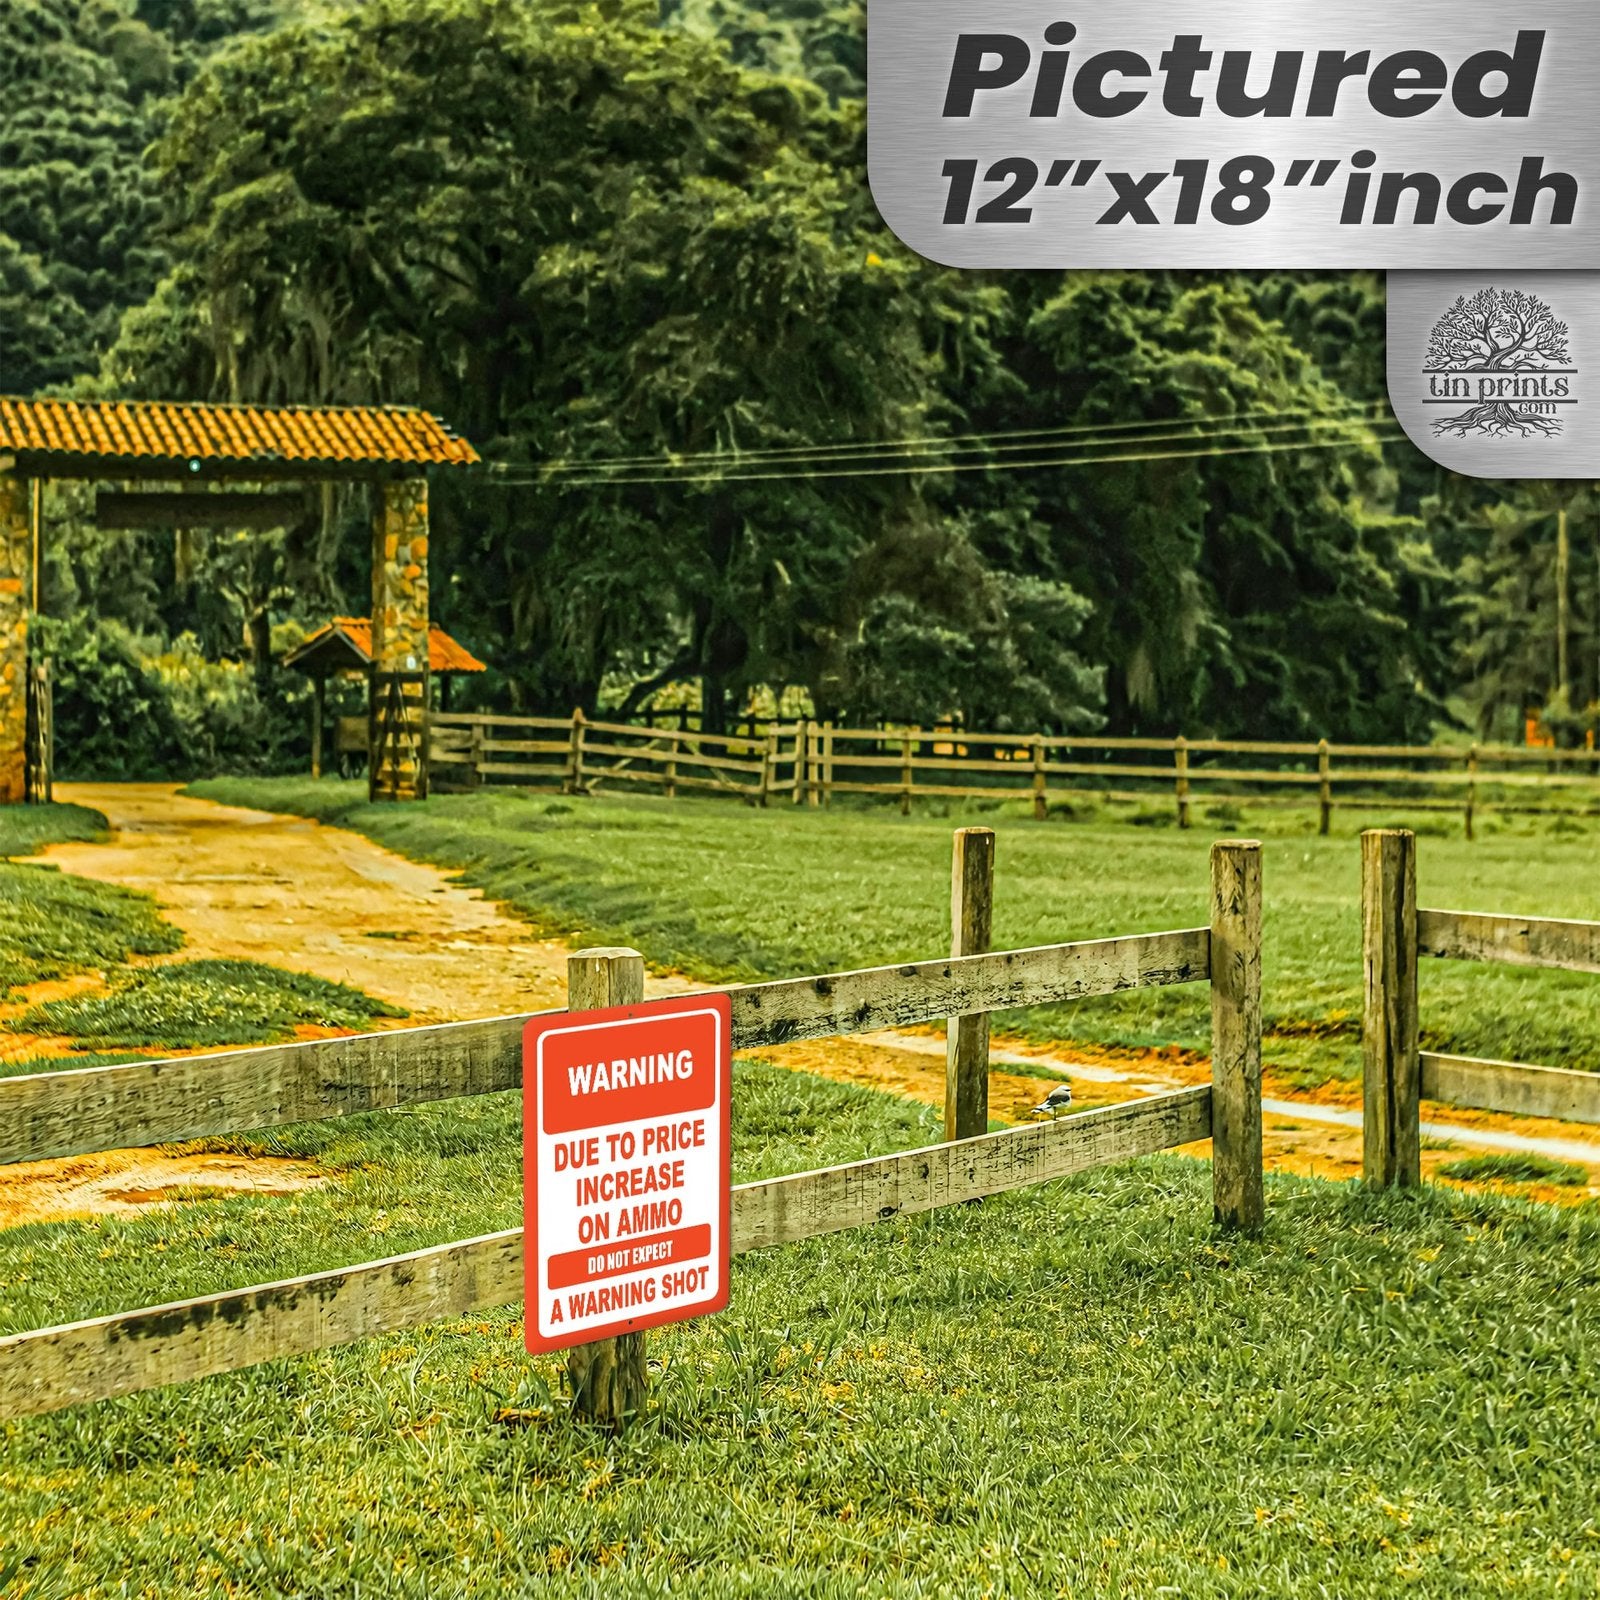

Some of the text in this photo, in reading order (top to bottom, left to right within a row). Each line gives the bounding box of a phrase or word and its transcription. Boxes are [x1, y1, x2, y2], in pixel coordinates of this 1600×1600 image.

[568, 1049, 693, 1096] WARNING
[554, 1119, 705, 1172] DUE TO PRICE
[576, 1159, 684, 1207] INCREASE
[578, 1198, 682, 1245] ON AMMO
[587, 1240, 673, 1275] DO NOT EXPECT
[550, 1266, 709, 1325] A WARNING SHOT
